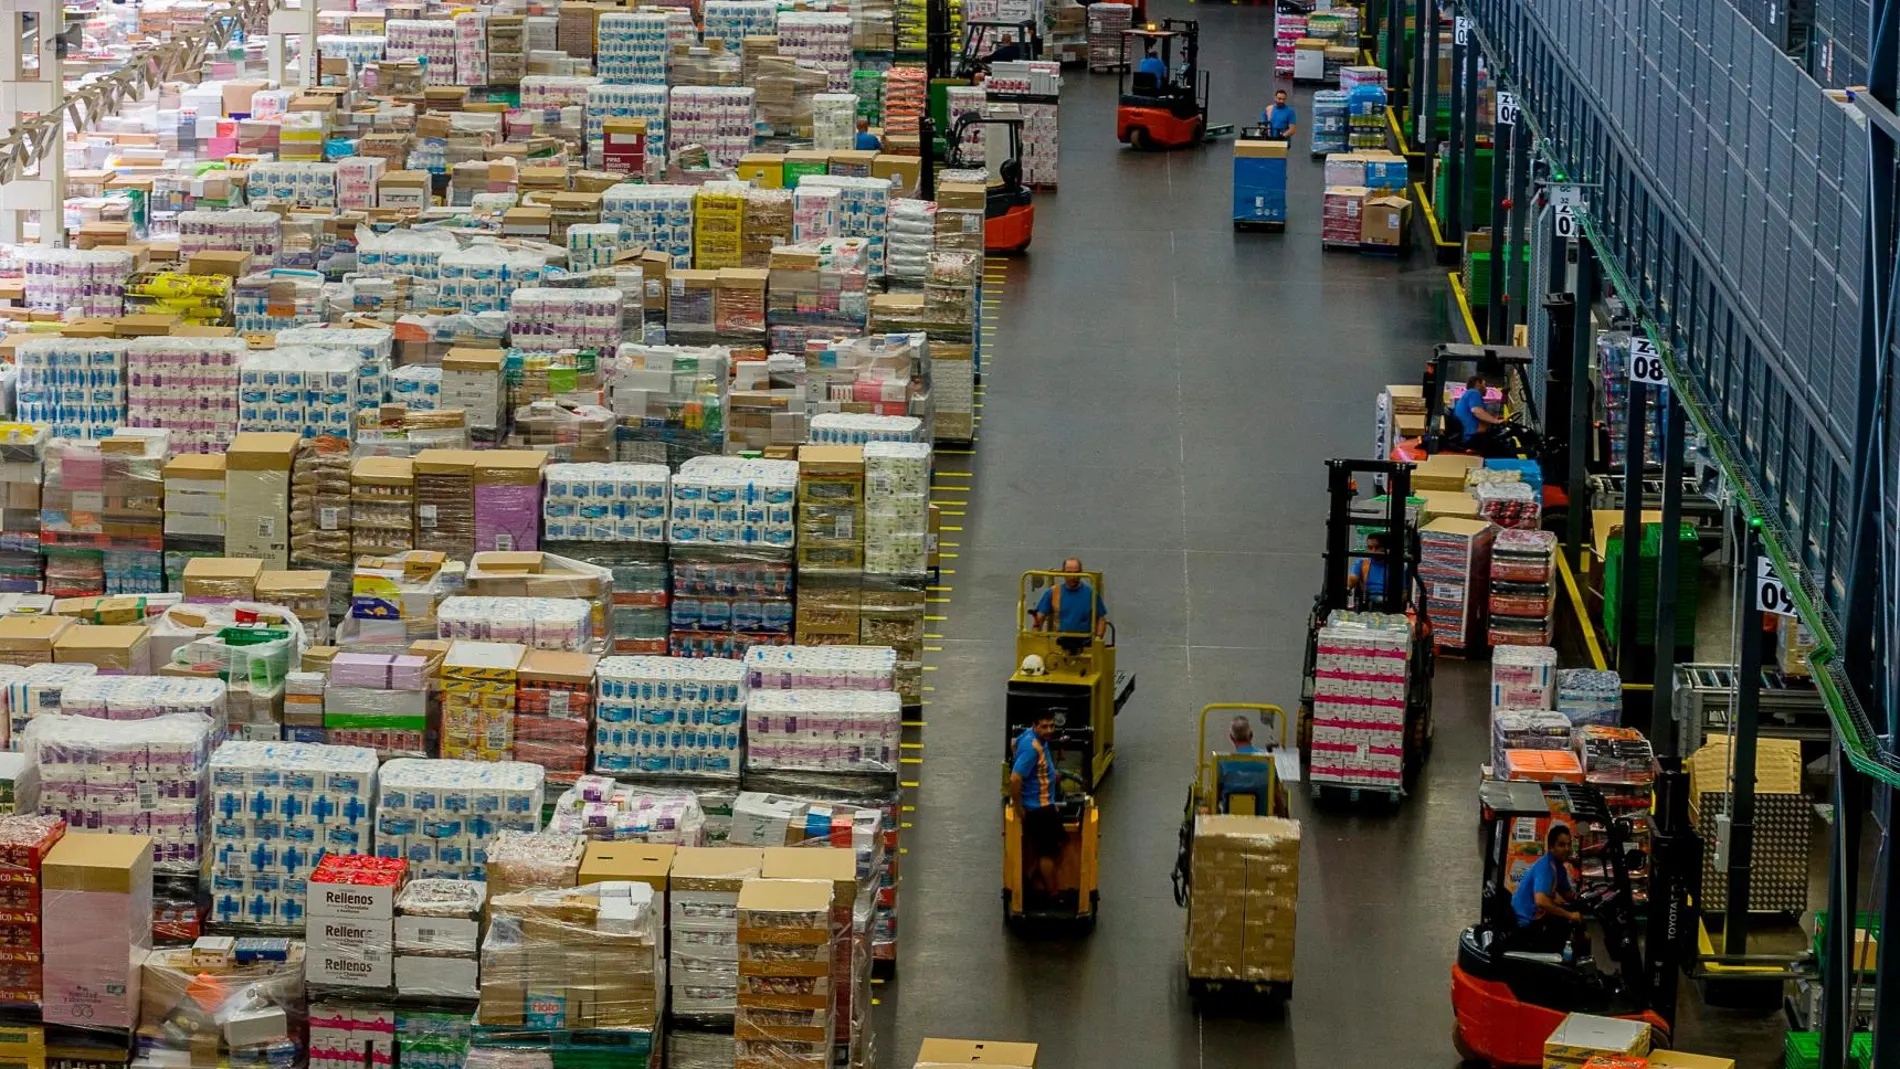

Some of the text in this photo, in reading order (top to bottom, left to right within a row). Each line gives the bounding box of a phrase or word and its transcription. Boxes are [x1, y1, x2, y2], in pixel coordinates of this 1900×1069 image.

[1633, 356, 1664, 381] 08
[1761, 582, 1795, 613] 09
[326, 891, 373, 905] Rellenos
[1667, 901, 1678, 940] TOYOTA
[325, 925, 366, 939] Rellen
[324, 958, 373, 973] Rellenos
